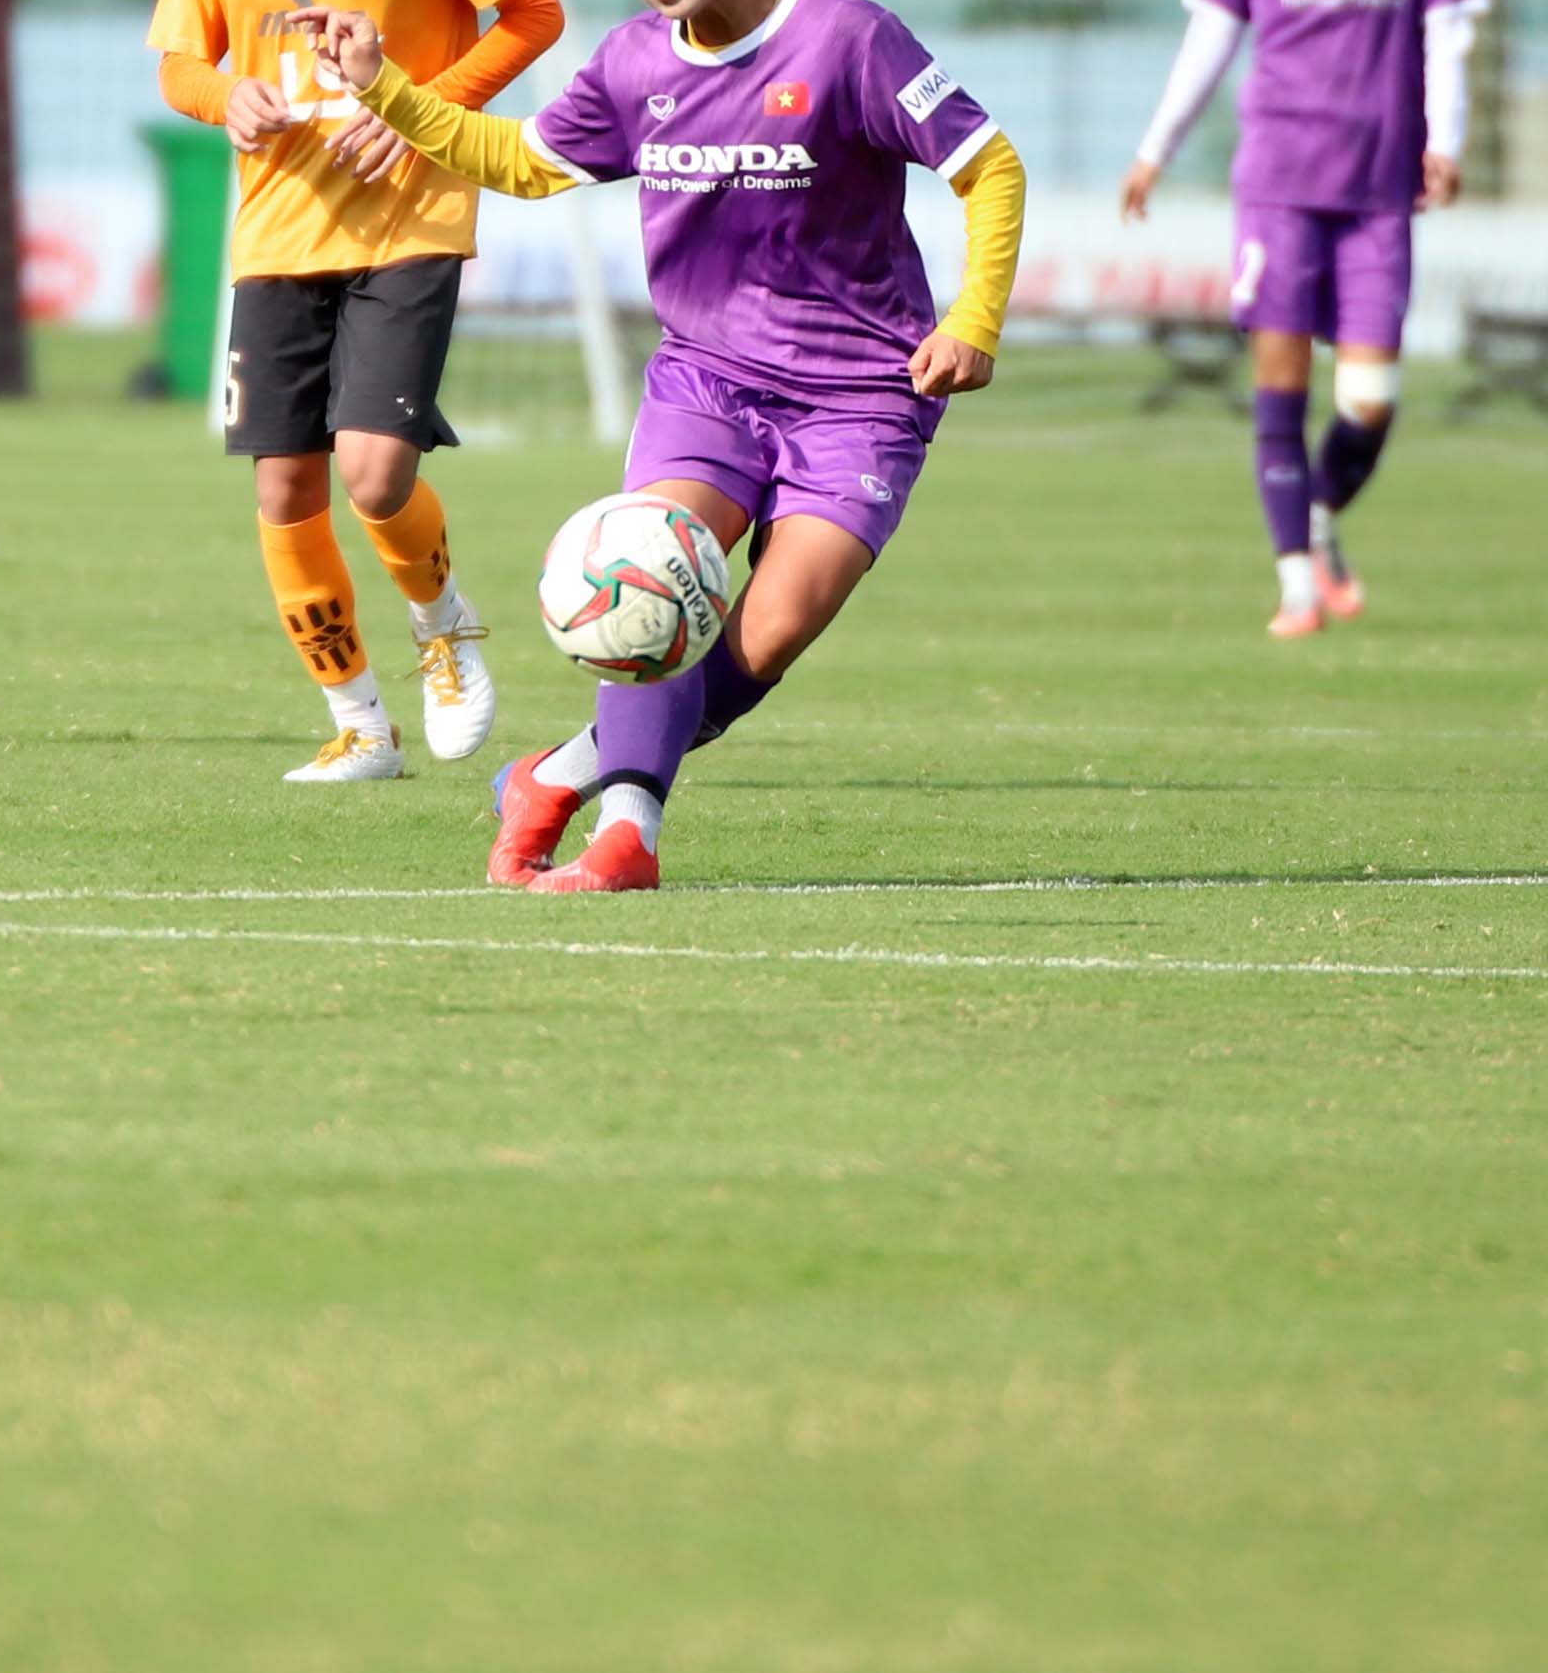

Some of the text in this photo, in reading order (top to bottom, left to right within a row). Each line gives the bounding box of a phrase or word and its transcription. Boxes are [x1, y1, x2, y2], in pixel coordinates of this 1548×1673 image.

[905, 70, 951, 110] VINA
[640, 143, 818, 174] HONDA
[643, 176, 812, 194] The Power of Dreams
[665, 556, 714, 638] molten
